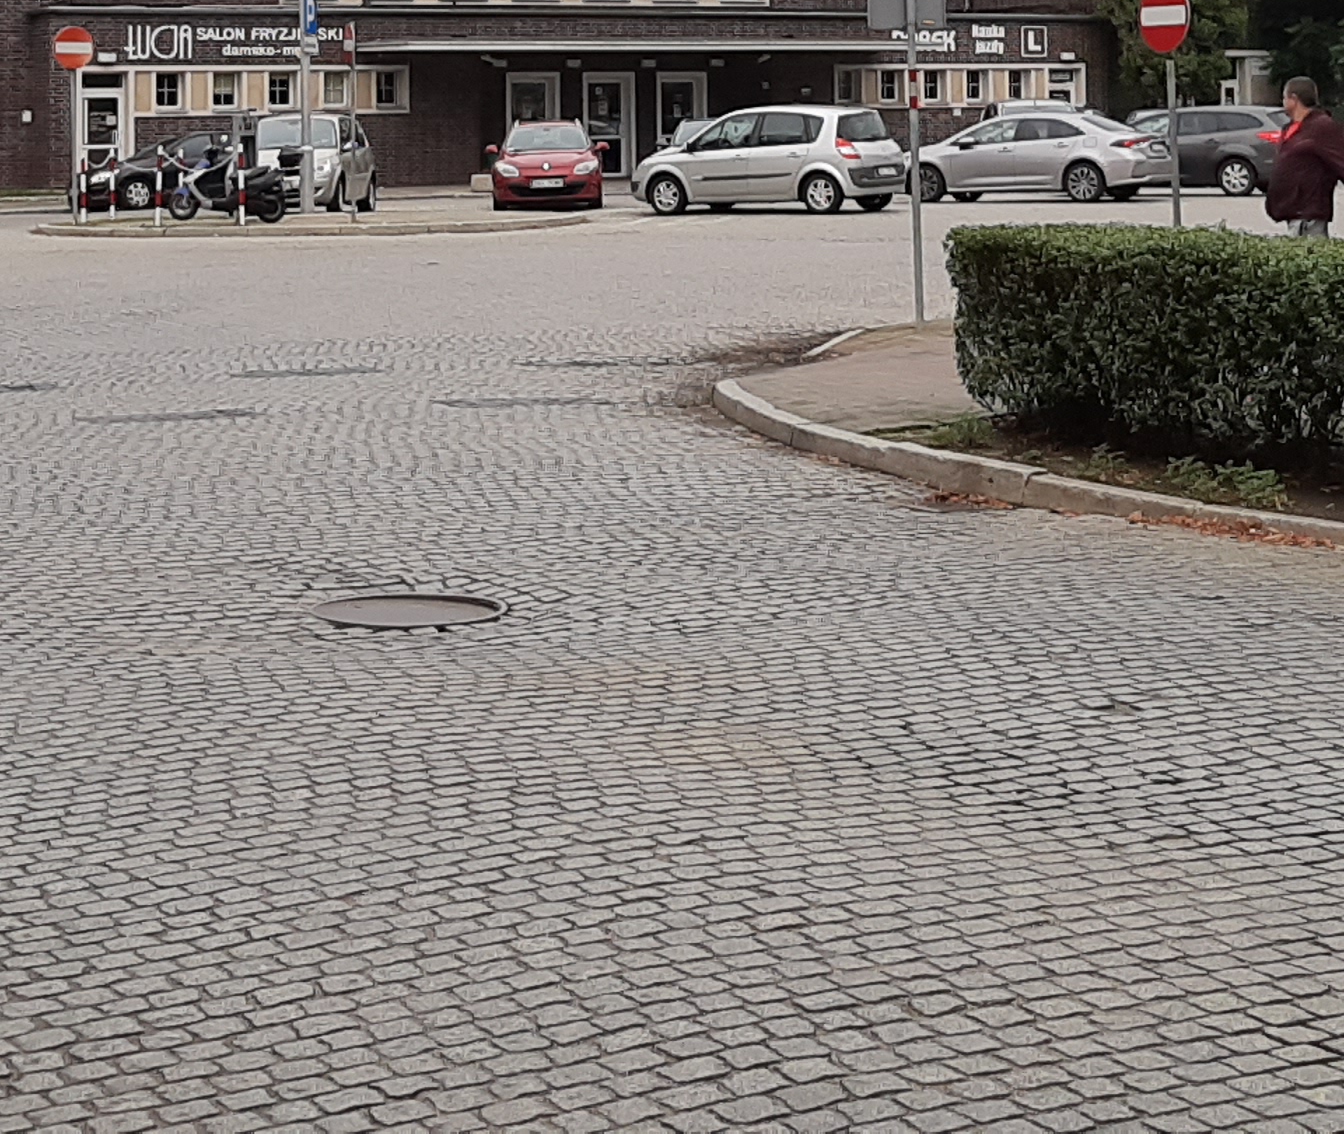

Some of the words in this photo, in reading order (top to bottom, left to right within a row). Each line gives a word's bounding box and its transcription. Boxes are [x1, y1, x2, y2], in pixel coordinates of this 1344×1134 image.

[196, 26, 246, 41] SALON
[251, 26, 343, 41] FRYZJSKI
[1027, 30, 1042, 51] L
[222, 44, 301, 56] damsko-m
